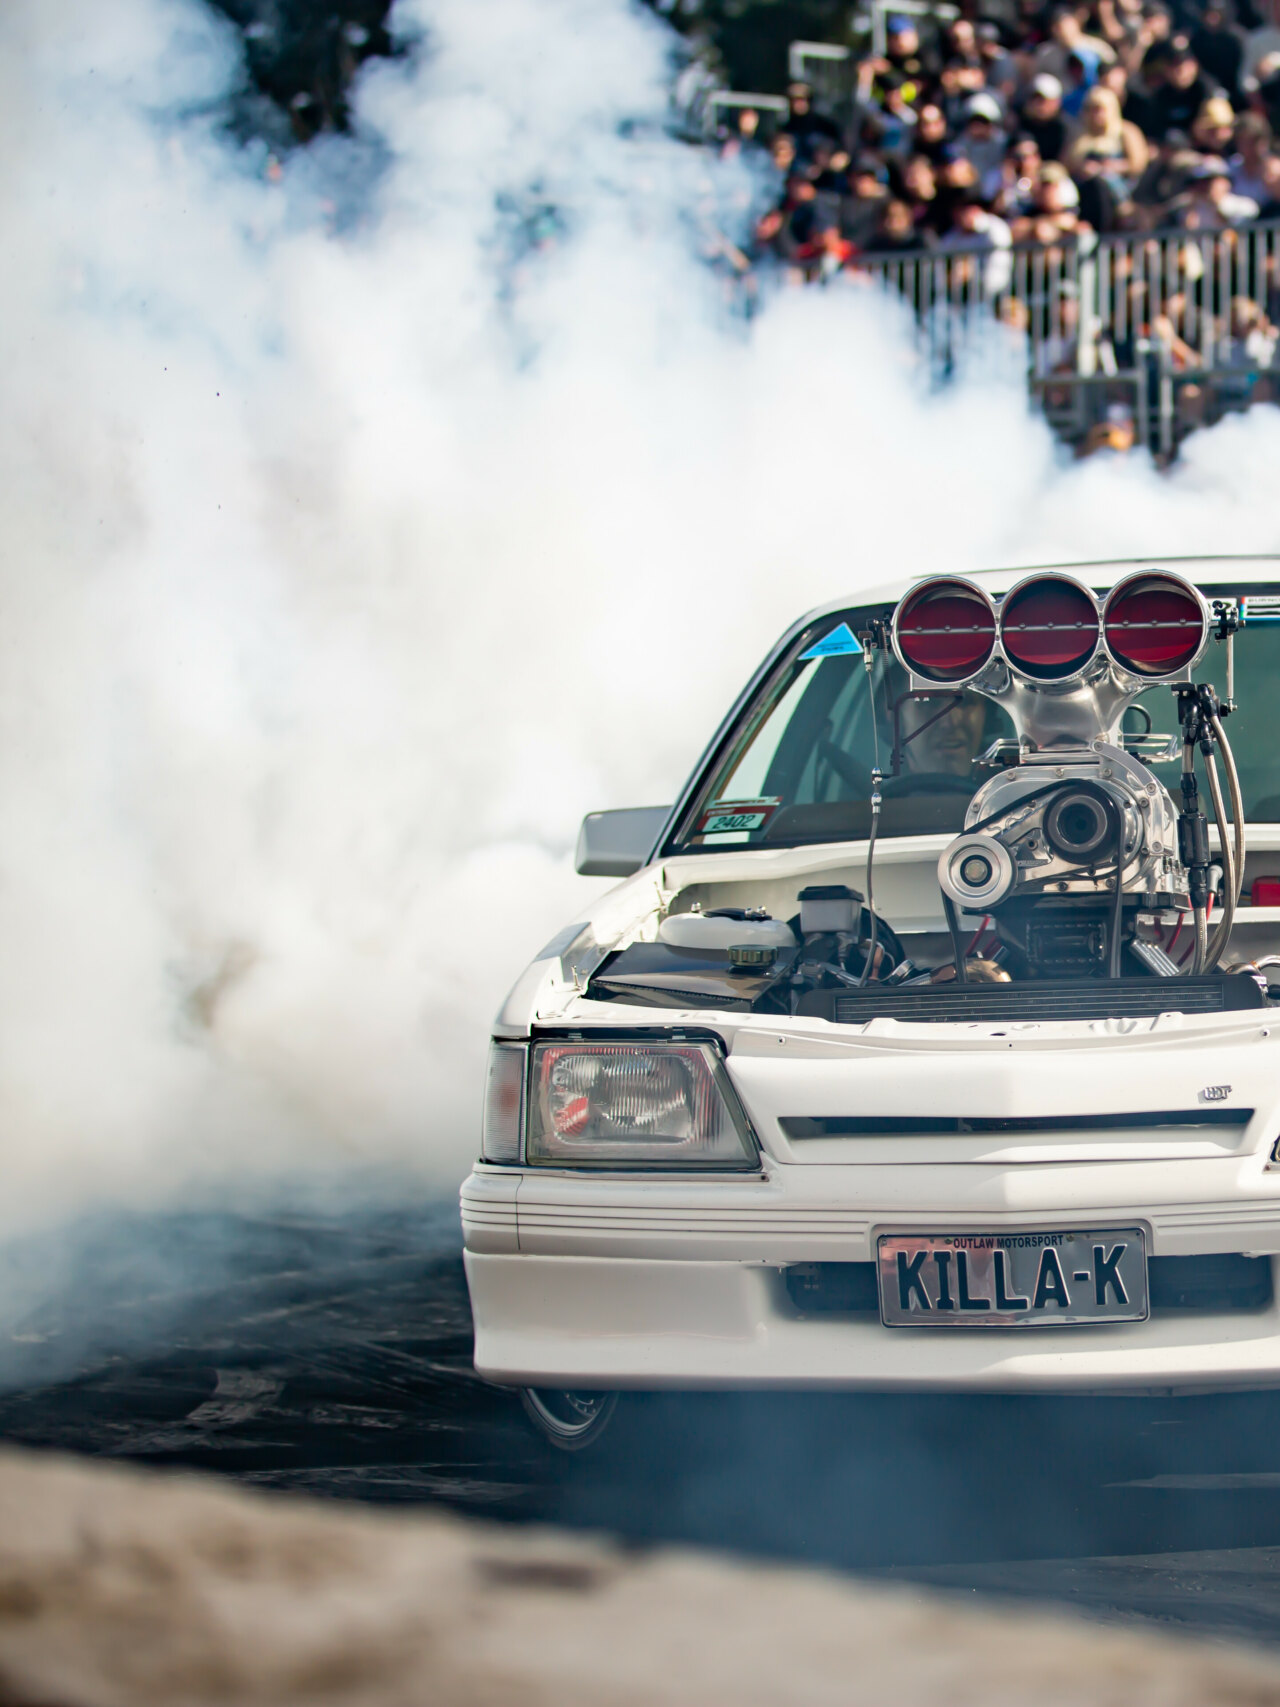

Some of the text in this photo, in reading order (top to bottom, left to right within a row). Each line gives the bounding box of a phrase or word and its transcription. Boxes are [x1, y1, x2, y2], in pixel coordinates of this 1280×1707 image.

[711, 814, 756, 830] 2402
[953, 1234, 1064, 1249] OUTLAW MOTORSPORT
[897, 1244, 1130, 1310] KILLA-K
